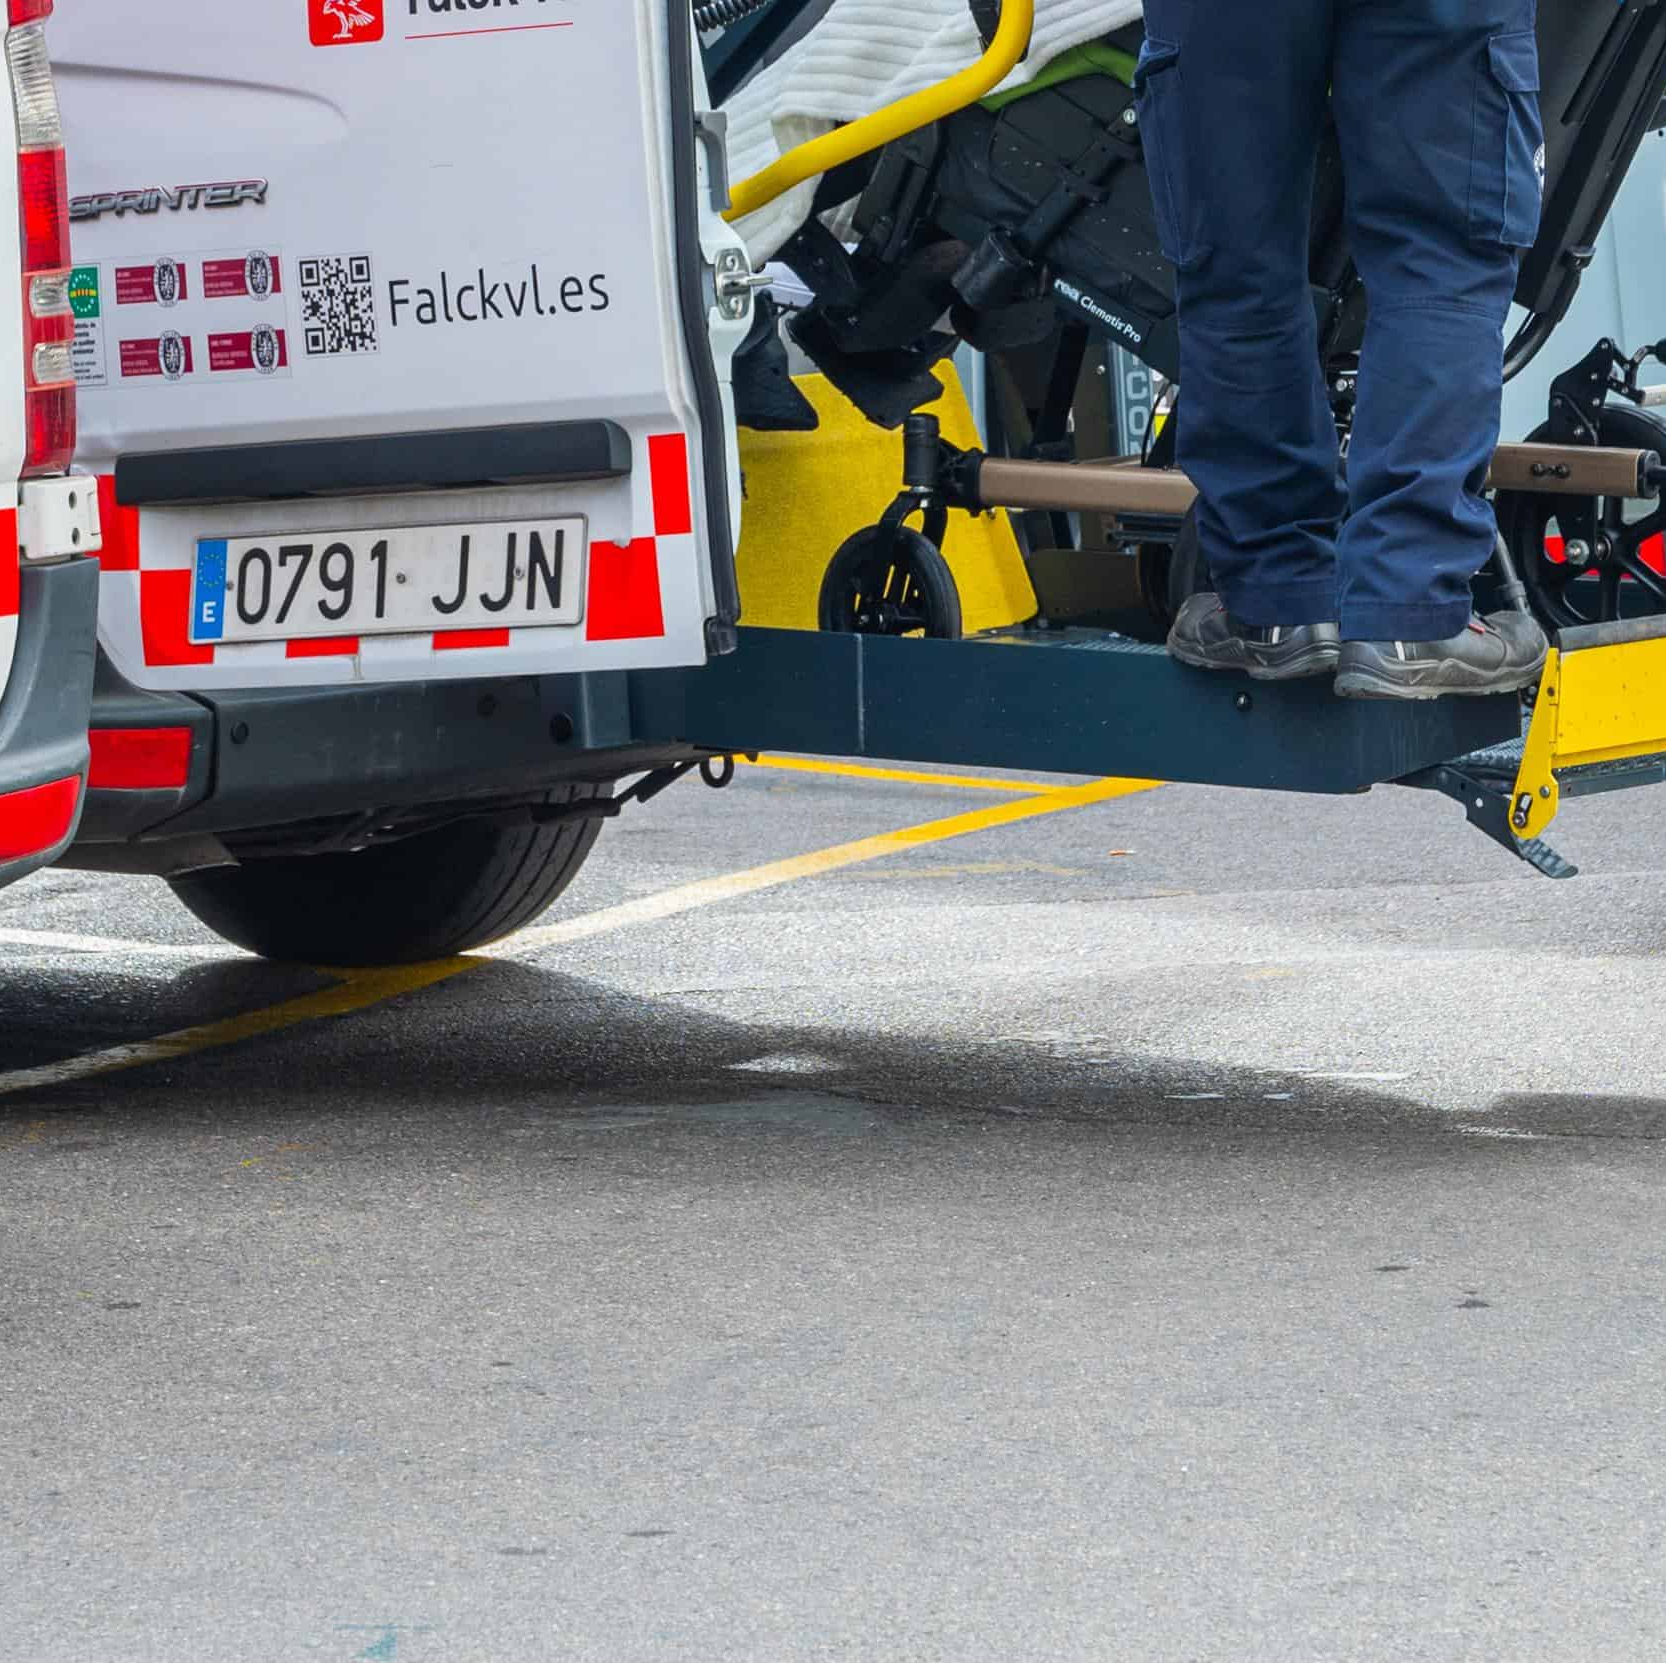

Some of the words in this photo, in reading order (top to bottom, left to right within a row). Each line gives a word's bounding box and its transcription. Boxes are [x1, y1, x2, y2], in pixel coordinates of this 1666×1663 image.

[69, 178, 268, 222] SPRINTER
[389, 263, 610, 327] Falckvl.es
[236, 539, 388, 625] 0791
[433, 528, 565, 615] JJN
[202, 600, 217, 623] E
